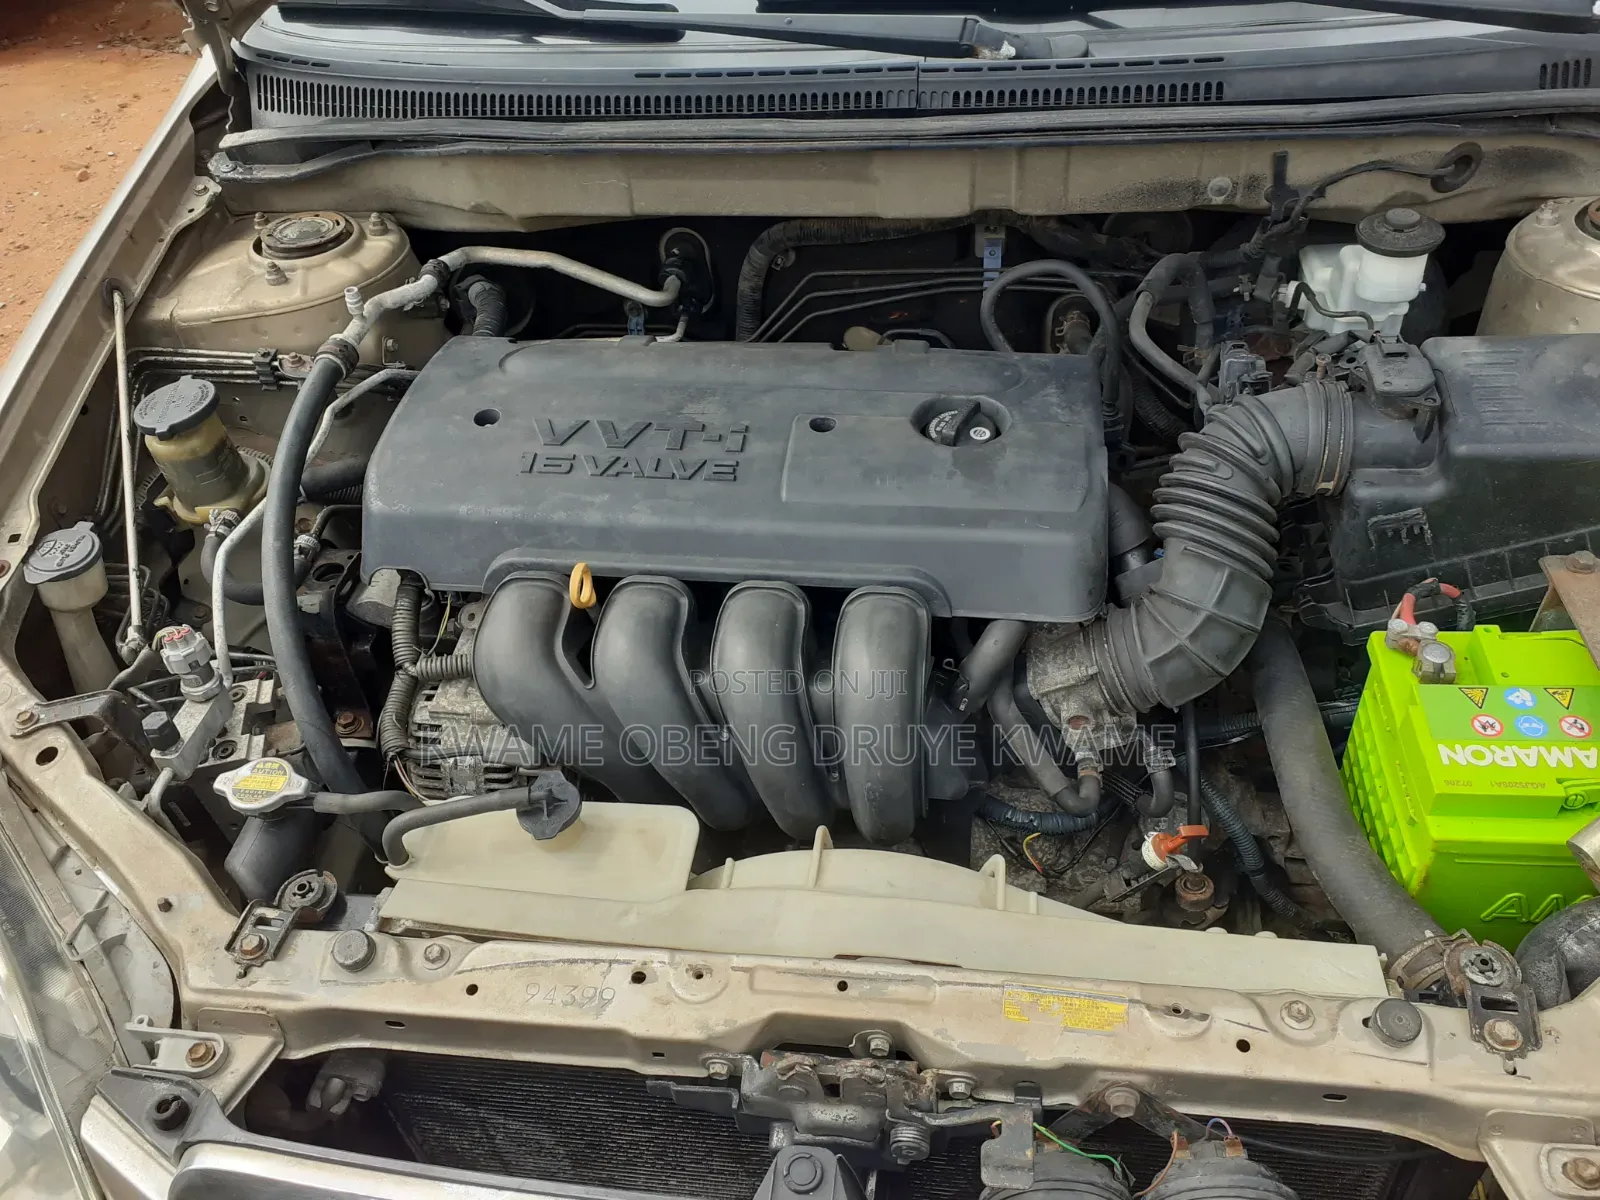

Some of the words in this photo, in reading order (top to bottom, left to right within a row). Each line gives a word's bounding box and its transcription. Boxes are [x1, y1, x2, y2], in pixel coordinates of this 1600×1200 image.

[533, 417, 749, 453] VVT-i
[520, 451, 577, 475] 16
[581, 453, 740, 482] VALVE
[1437, 743, 1598, 769] AMARON
[524, 982, 617, 1009] 94399
